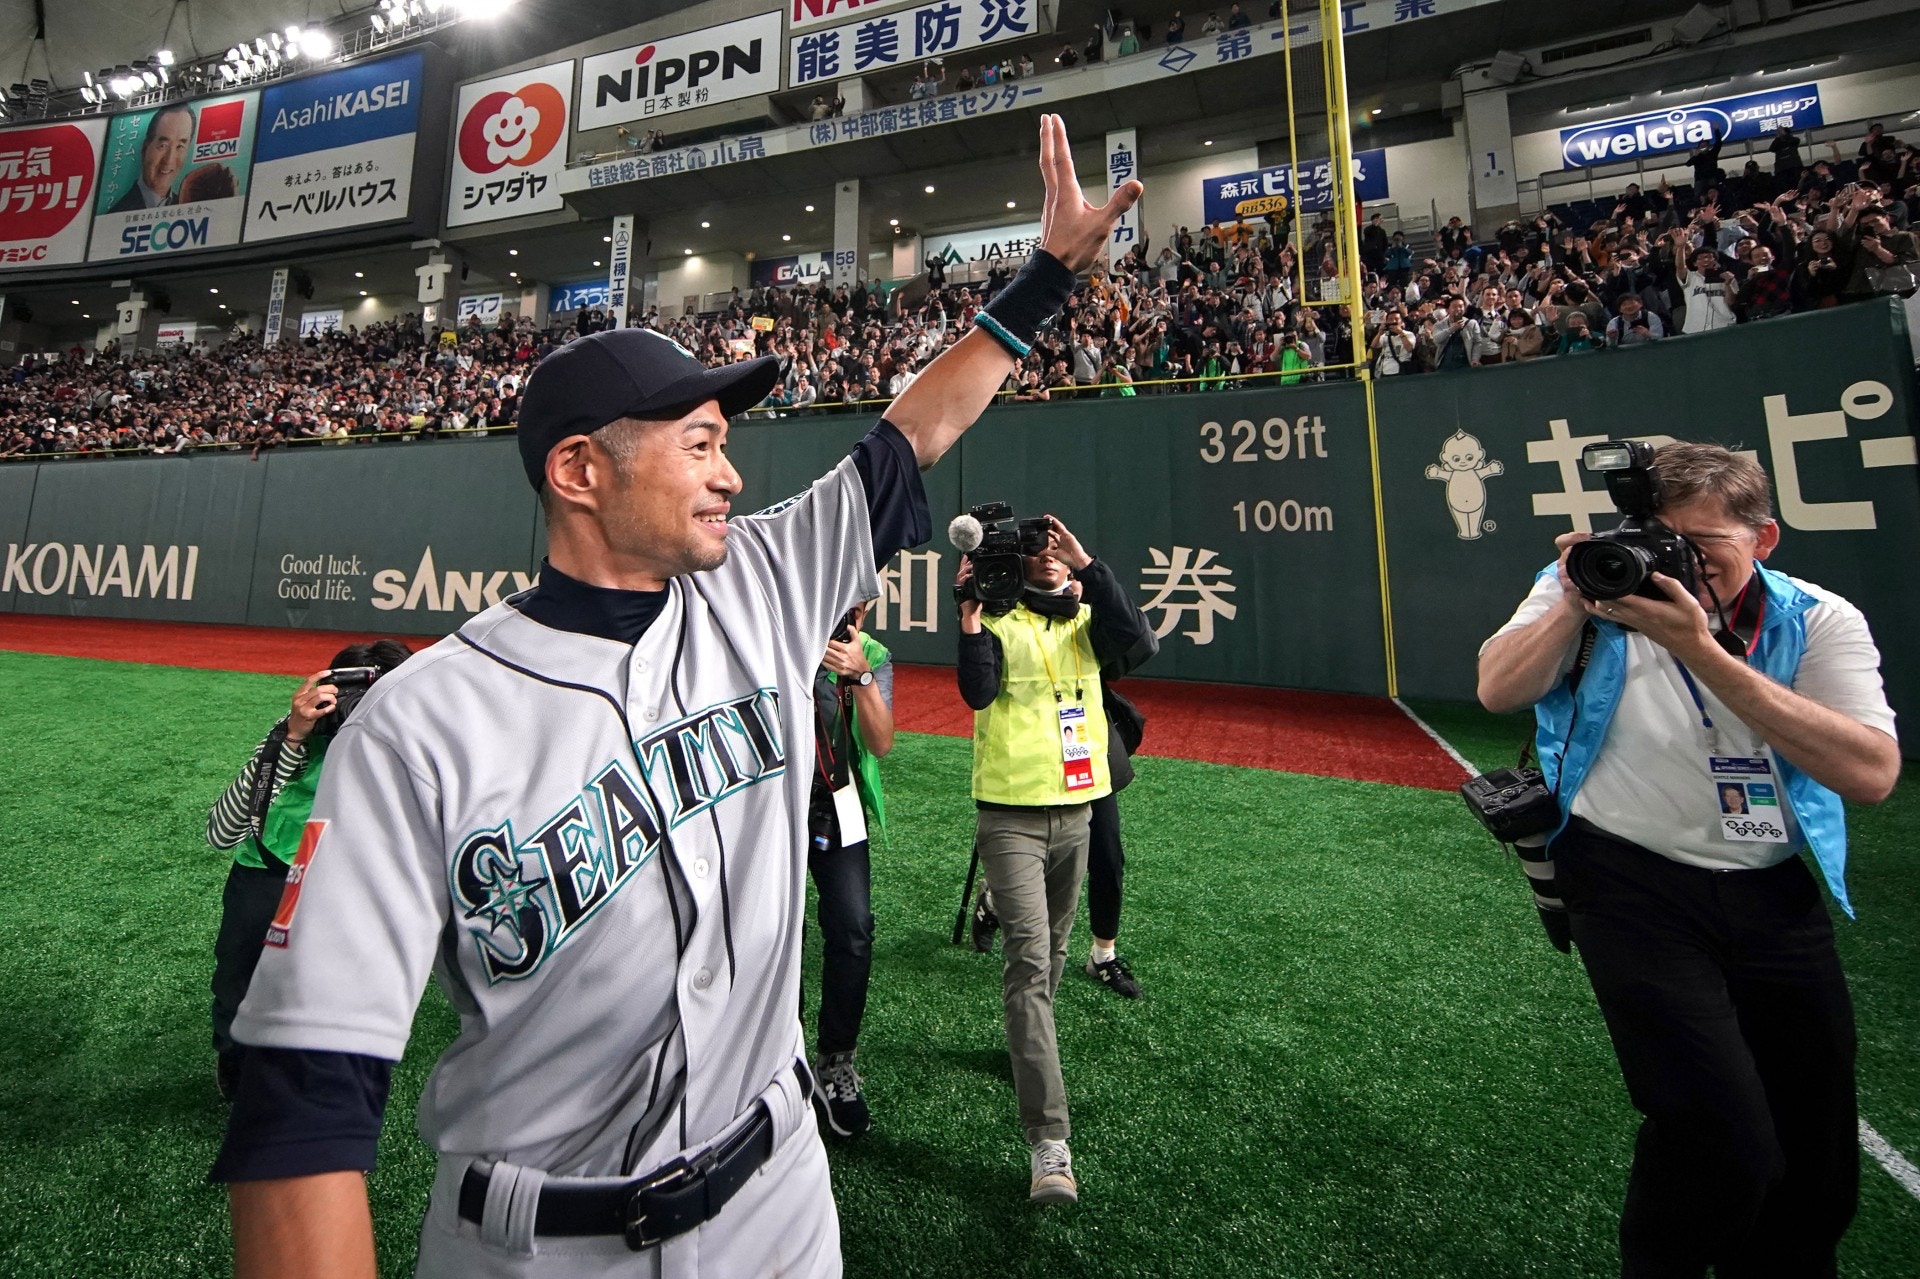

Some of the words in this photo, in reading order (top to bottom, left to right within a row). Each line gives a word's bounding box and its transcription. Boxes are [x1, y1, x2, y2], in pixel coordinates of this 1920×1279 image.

[797, 0, 1029, 82] 能美防災
[271, 80, 410, 134] AsahiKASEI
[644, 88, 709, 115] 日本製粉
[1731, 96, 1817, 122] ウエルシア
[1577, 112, 1713, 161] welcia
[1759, 115, 1794, 133] 薬局
[196, 140, 237, 158] SECOM
[284, 161, 379, 187] 考えよう。答はある。
[588, 152, 685, 187] 住設総合商社
[258, 178, 397, 222] ヘーベルハウス
[463, 171, 548, 210] シマダヤ
[120, 217, 209, 255] SECOM
[777, 261, 832, 281] GALA
[836, 251, 855, 265] 58
[426, 275, 434, 290] 1
[611, 247, 627, 308] 三機工業
[125, 310, 133, 323] 3
[1199, 416, 1329, 465] 329ft
[1233, 500, 1334, 533] 100m
[2, 541, 199, 601] KONAMI
[280, 554, 323, 576] Good
[327, 554, 367, 577] luck.
[278, 578, 320, 601] Good
[324, 578, 357, 602] life.
